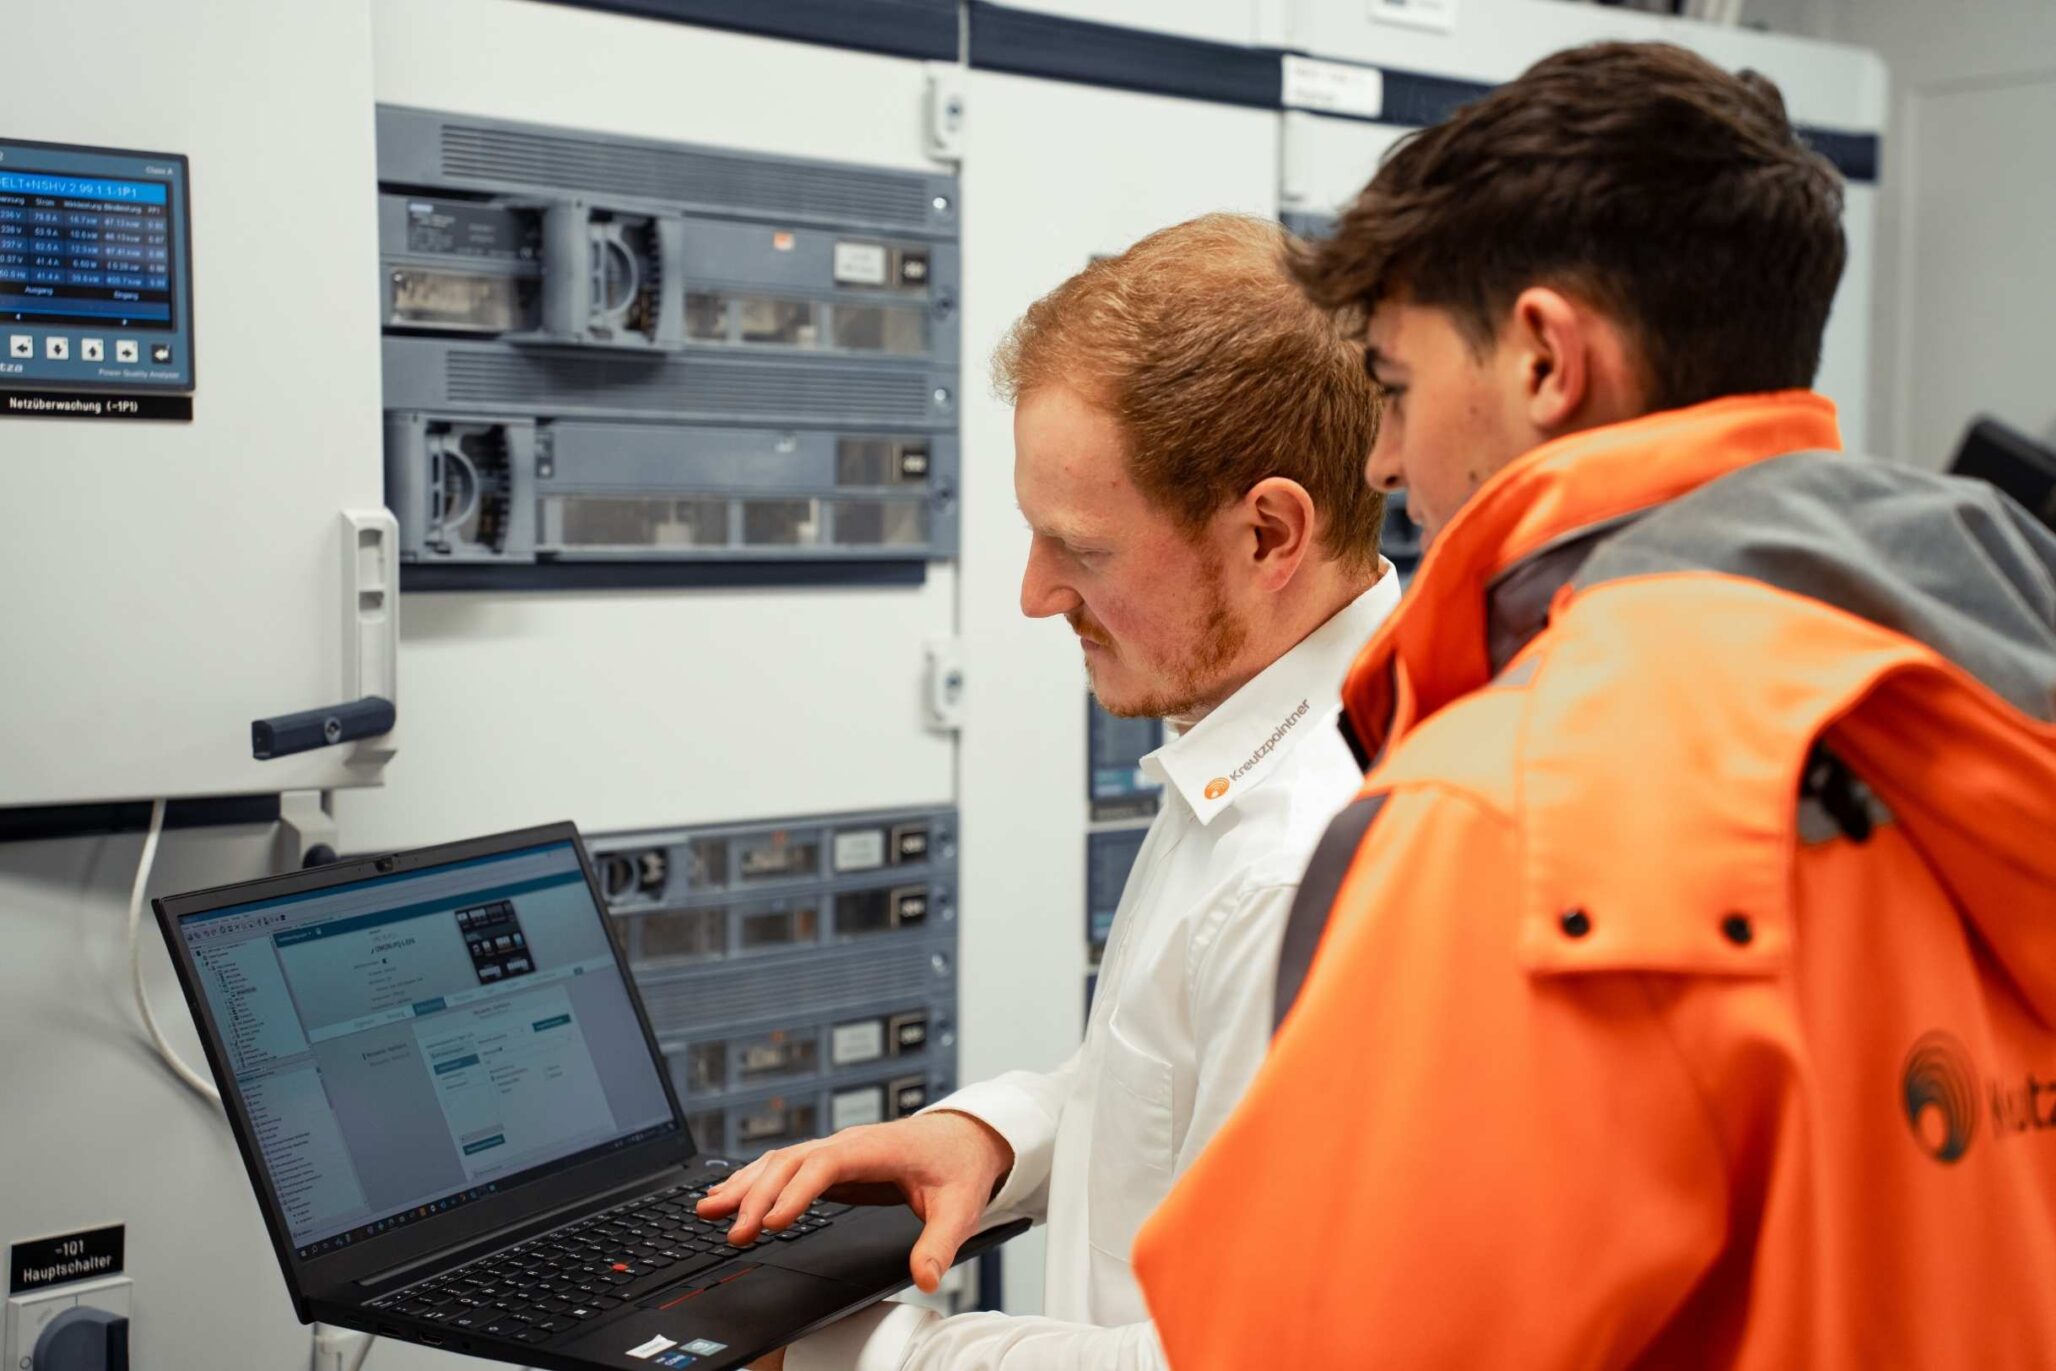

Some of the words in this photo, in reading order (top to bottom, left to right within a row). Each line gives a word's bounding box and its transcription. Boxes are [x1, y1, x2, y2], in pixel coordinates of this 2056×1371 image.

[98, 367, 122, 377] Power
[123, 368, 148, 380] Quality
[9, 396, 101, 414] Netzüberwachung
[1229, 699, 1310, 781] Kreutzpointner
[23, 1255, 112, 1283] Hauptschalter
